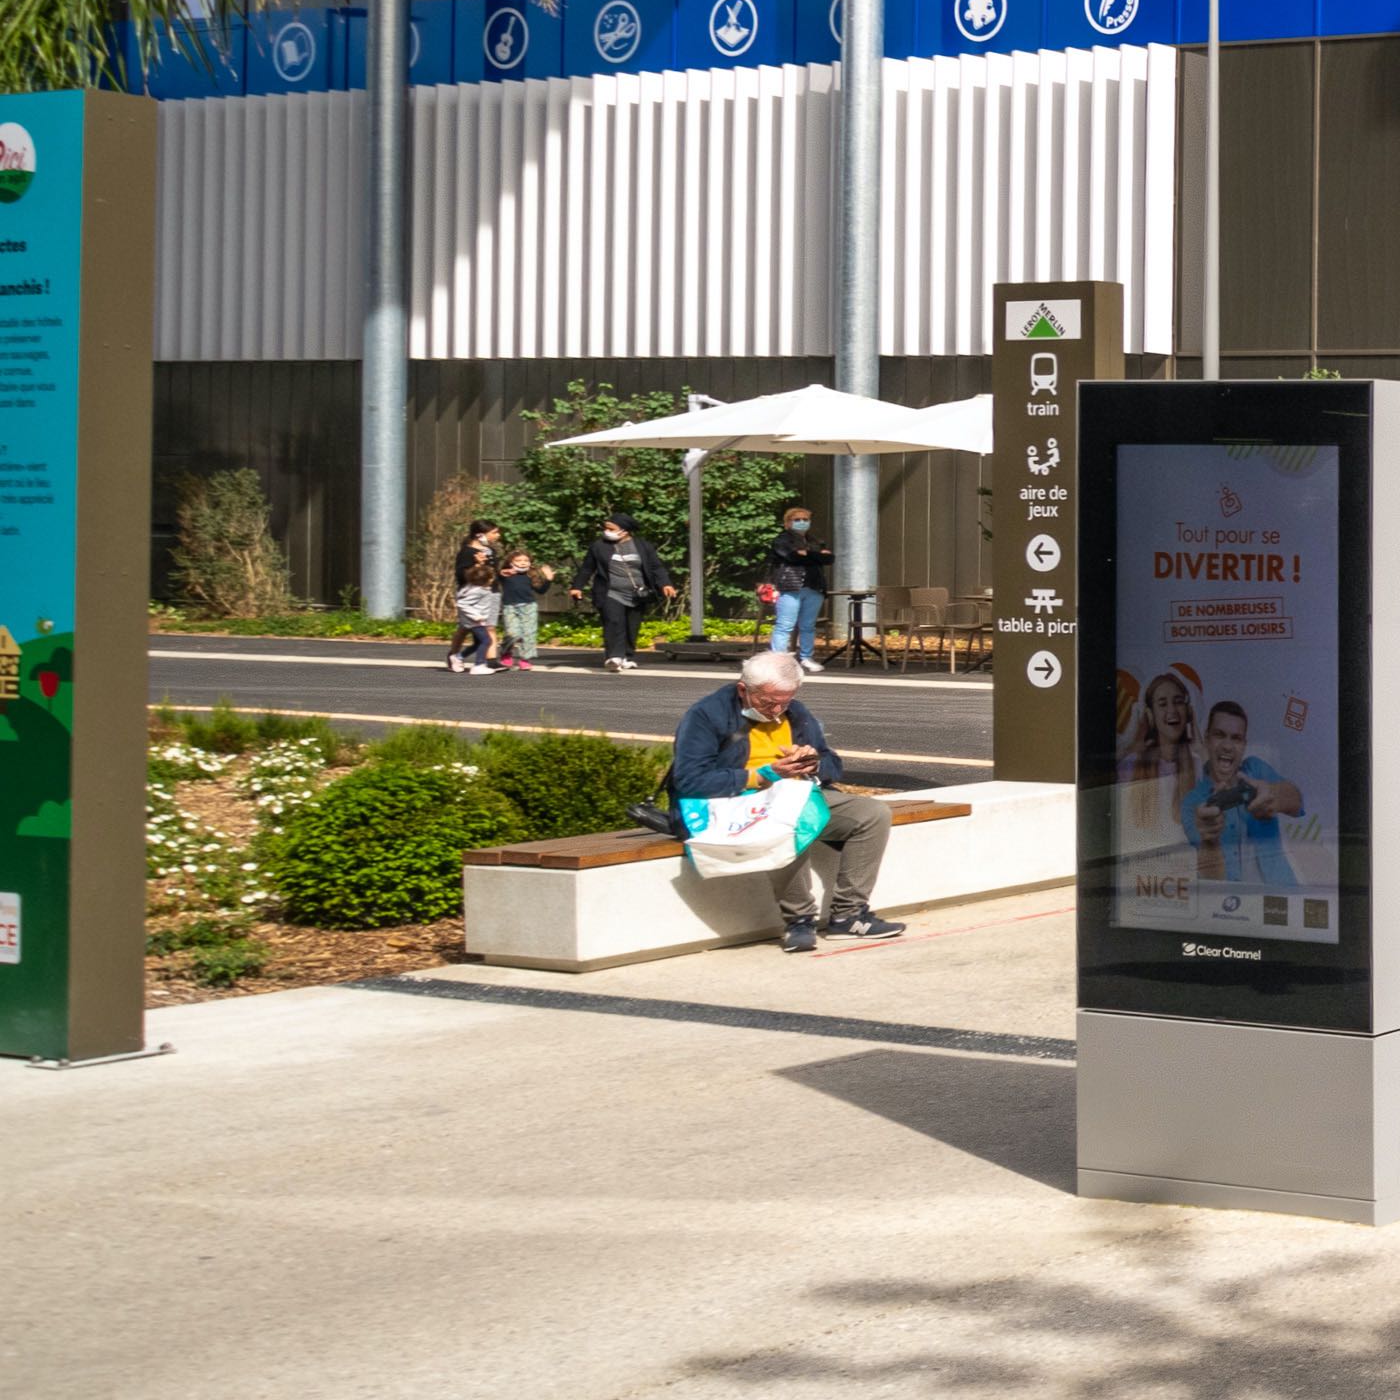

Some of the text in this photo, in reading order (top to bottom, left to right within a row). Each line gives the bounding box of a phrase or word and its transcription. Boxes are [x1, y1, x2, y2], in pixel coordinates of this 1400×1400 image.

[1020, 302, 1066, 337] LEROY MERLIN
[1027, 401, 1060, 416] train
[1019, 485, 1067, 500] aire de
[1027, 502, 1059, 521] jeux
[1175, 521, 1281, 549] Tout pour se
[1154, 551, 1285, 583] DIVERTIR
[1178, 602, 1277, 617] DE NOMBREUSES
[998, 618, 1033, 633] table
[1035, 618, 1044, 633] à
[1171, 622, 1286, 638] BOUTIQUES LOISIRS
[1136, 874, 1190, 901] NICE
[1196, 946, 1262, 961] Clear Channel
